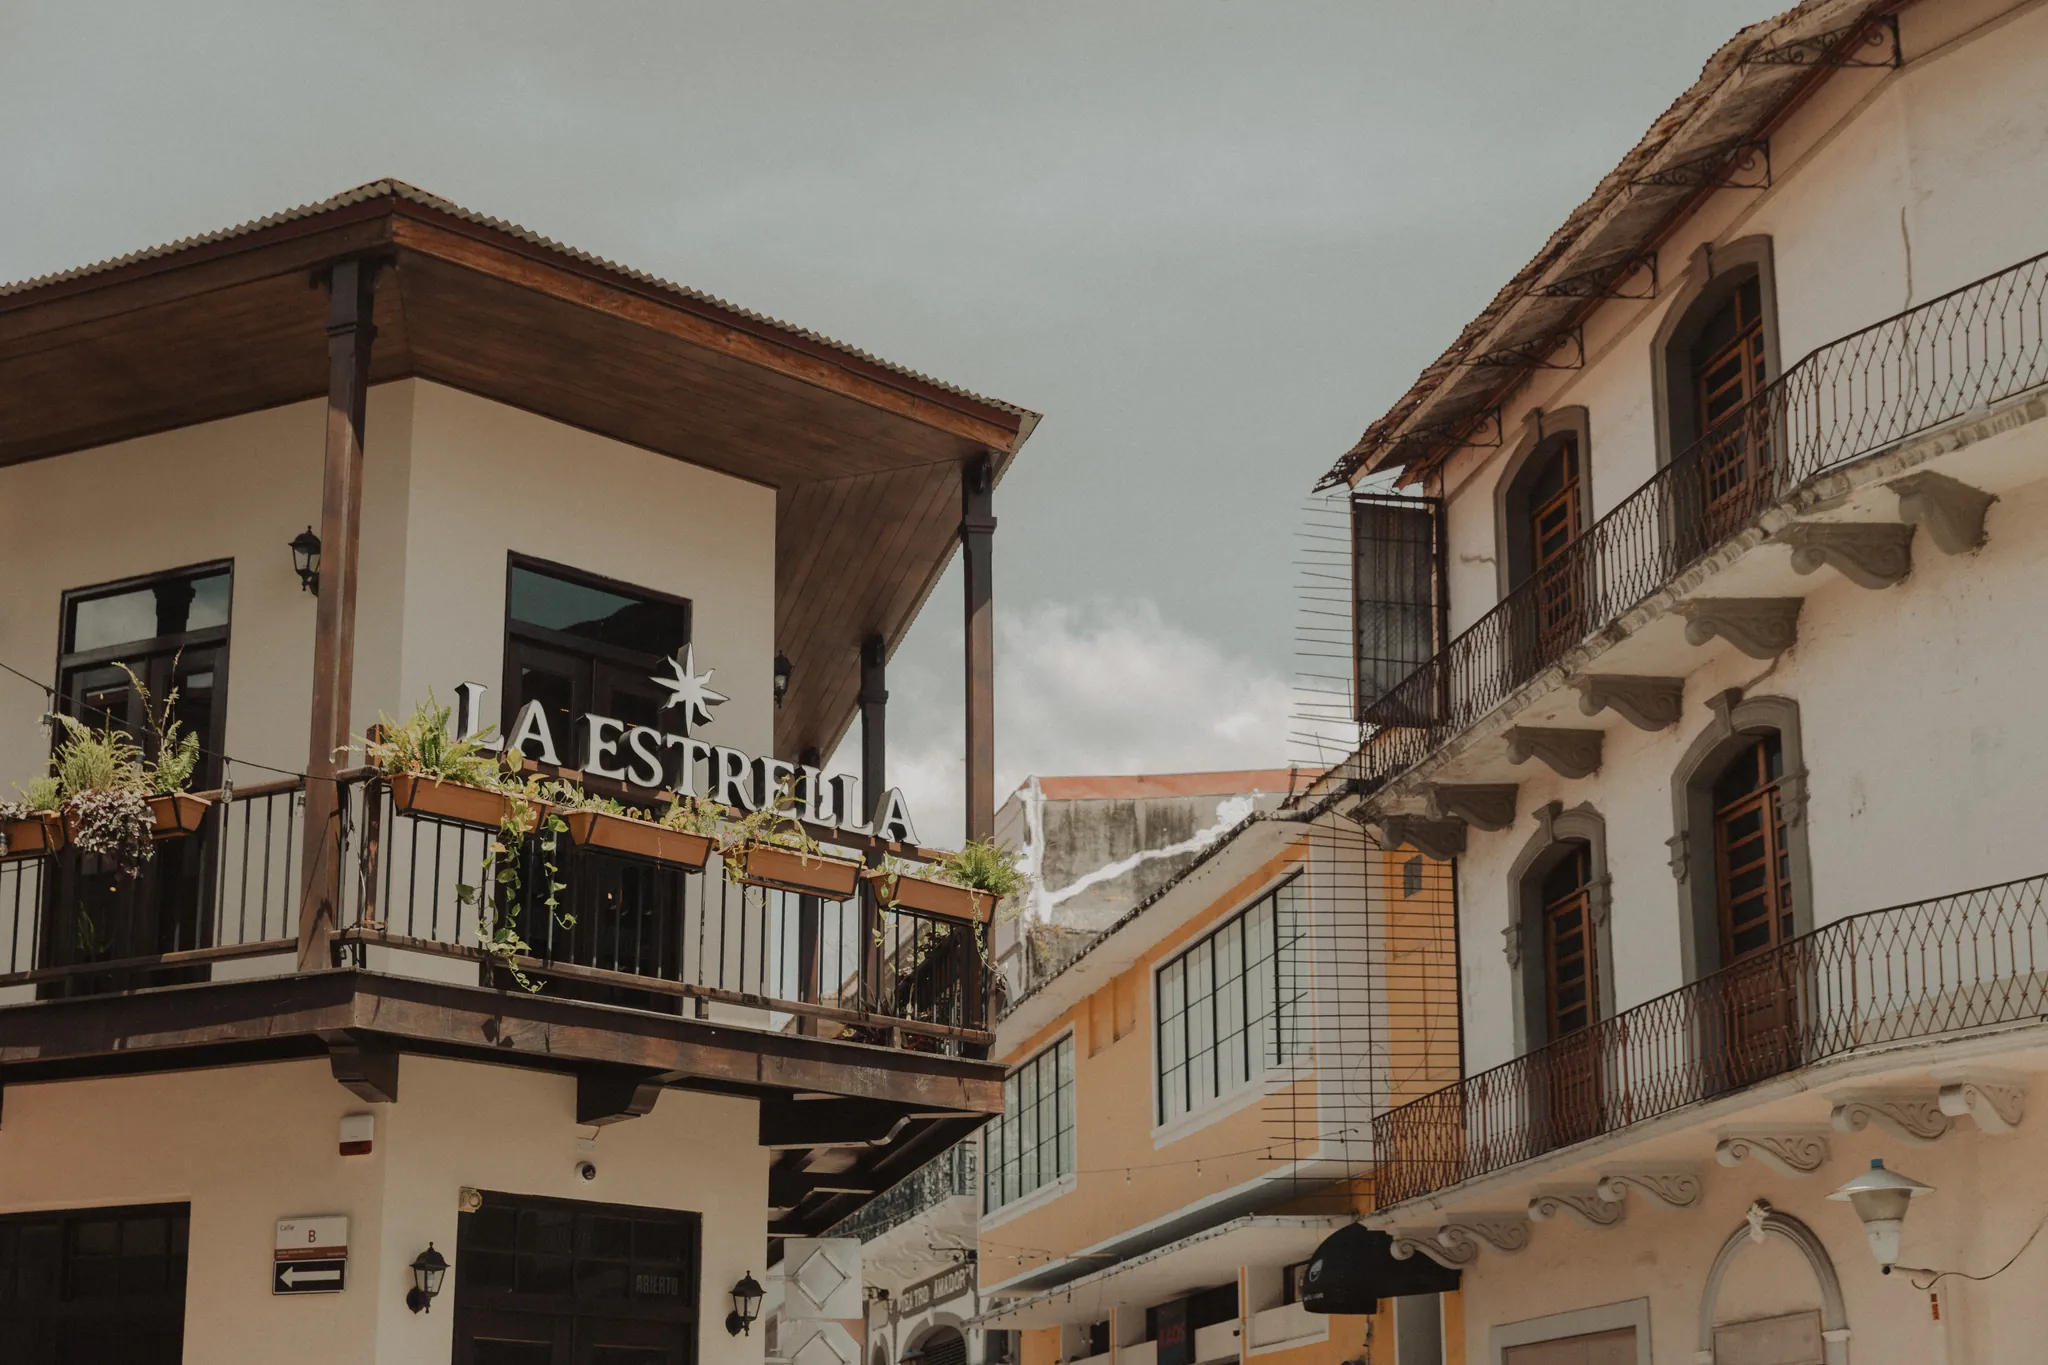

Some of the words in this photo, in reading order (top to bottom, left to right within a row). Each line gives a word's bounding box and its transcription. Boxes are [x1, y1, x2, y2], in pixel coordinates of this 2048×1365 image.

[457, 680, 563, 767] LA
[580, 712, 921, 847] ESTRELLA
[307, 1229, 317, 1243] B
[636, 1274, 678, 1296] ABIERTO
[933, 1268, 967, 1299] AMADOR
